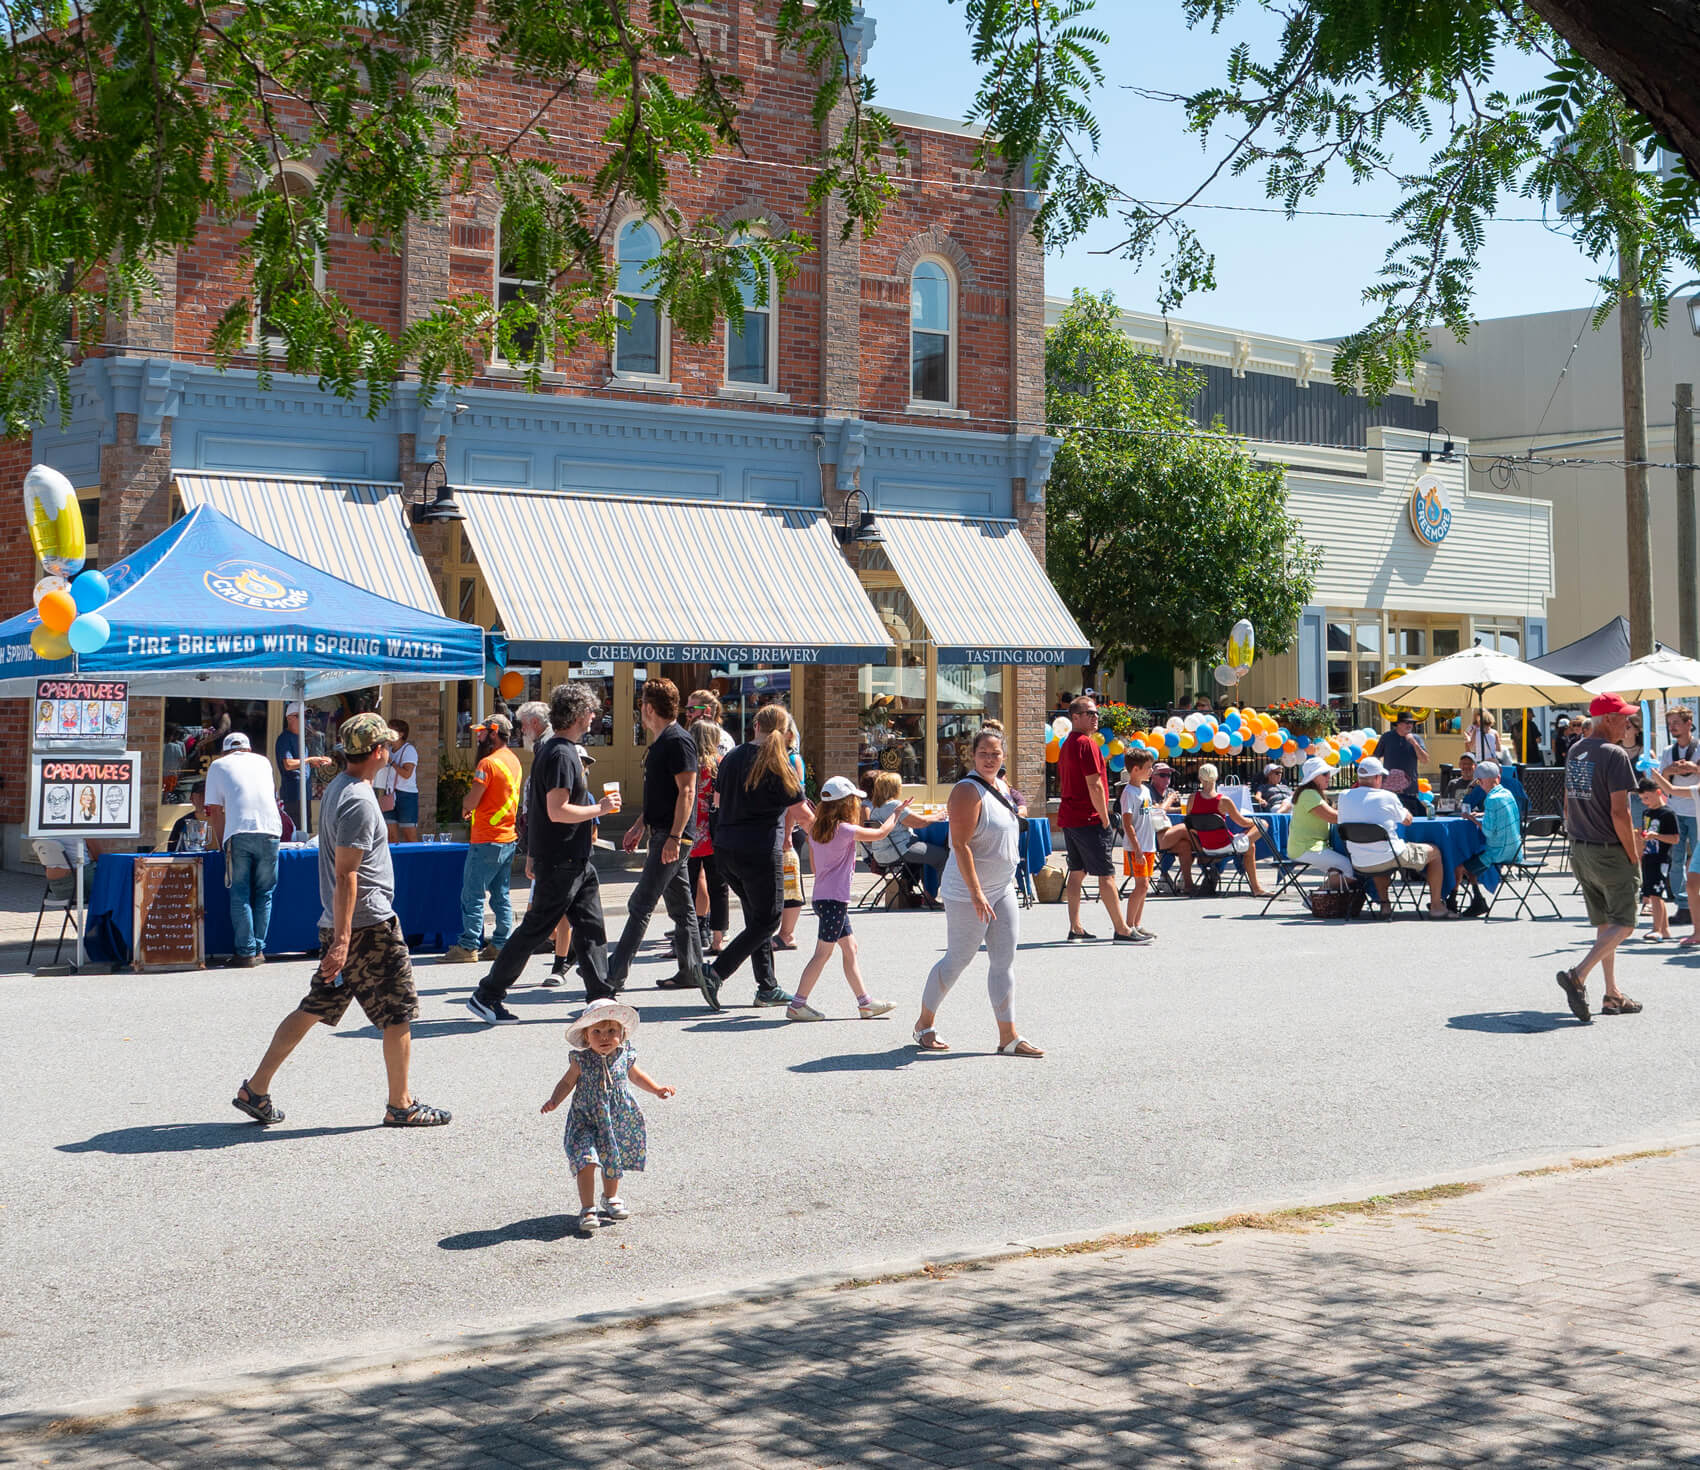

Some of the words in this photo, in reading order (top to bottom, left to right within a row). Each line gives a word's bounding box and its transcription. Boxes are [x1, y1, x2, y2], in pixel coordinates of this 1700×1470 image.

[1417, 500, 1450, 540] CREEMORE
[212, 579, 309, 609] CREEMORE
[127, 635, 172, 655] FIRE
[178, 634, 256, 654] BREWED
[262, 634, 308, 653] WITH
[314, 634, 380, 656] SPRING
[386, 638, 443, 659] WATER
[587, 645, 675, 660] CREEMORE
[682, 647, 748, 662] SPRINGS
[752, 648, 820, 662] BREWERY
[965, 650, 1022, 663] TASTING
[1026, 650, 1065, 663] ROOM
[38, 681, 125, 700] CARICATURES
[43, 762, 130, 781] CARICATURES
